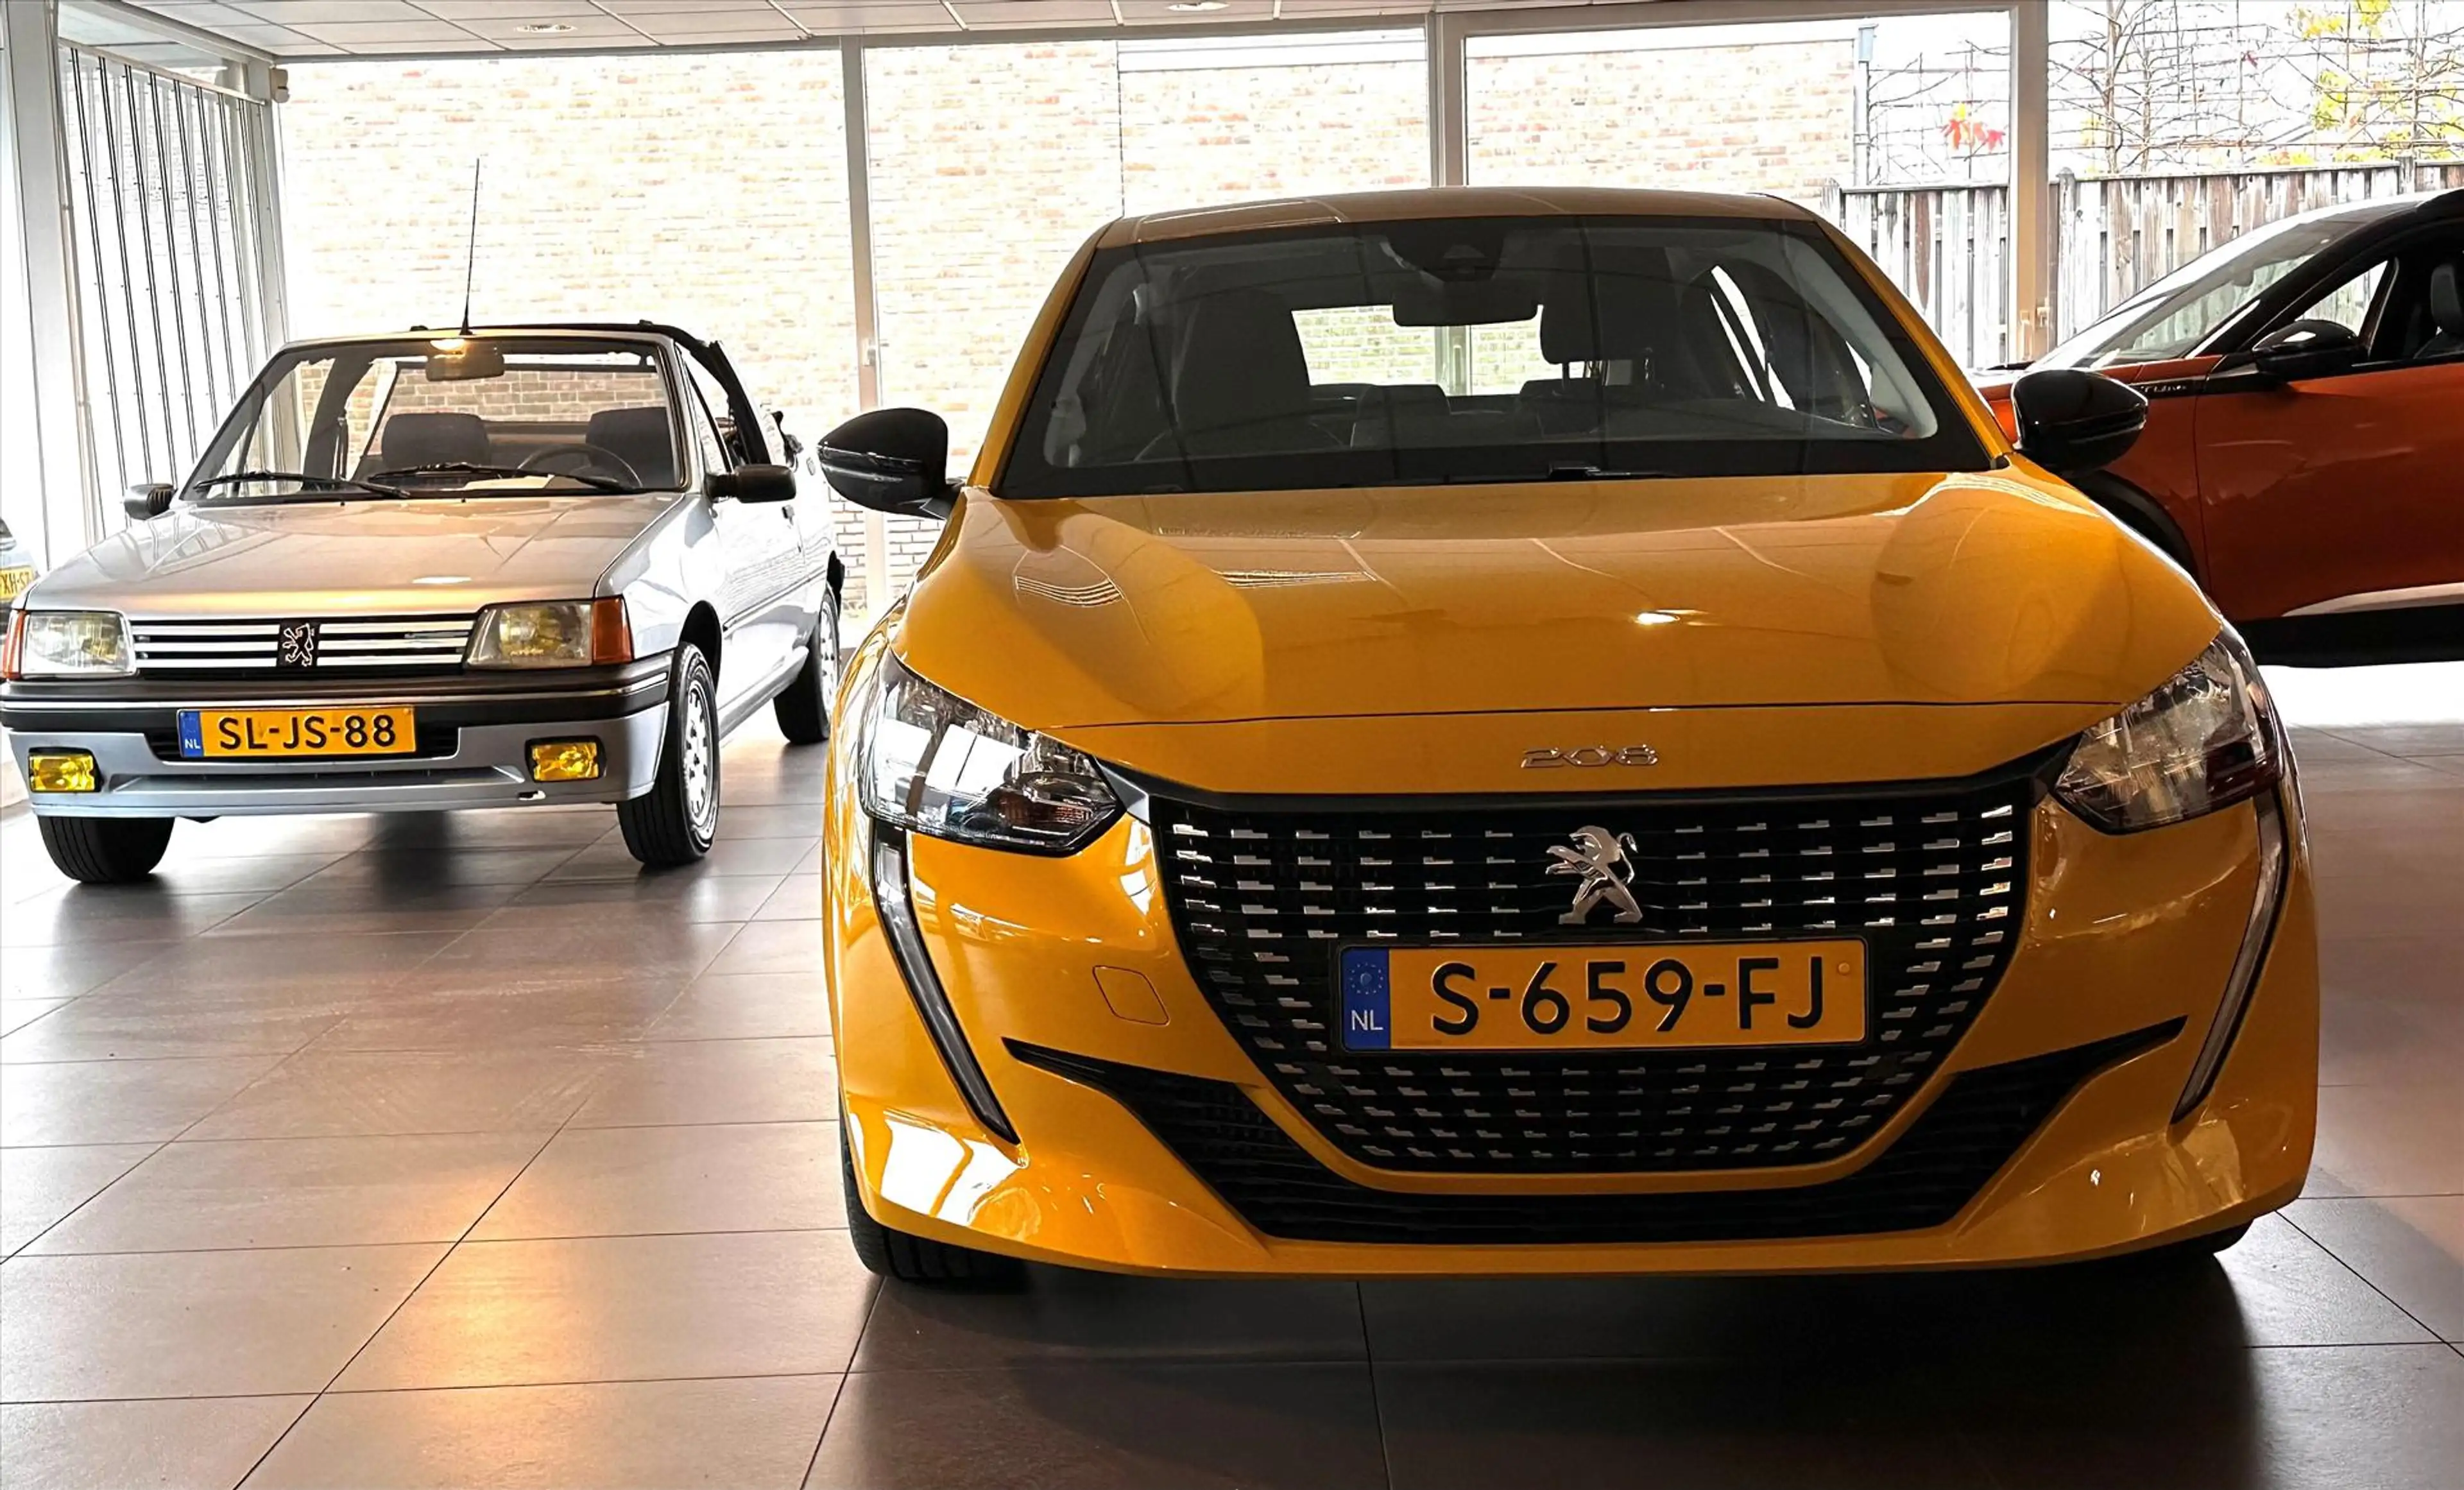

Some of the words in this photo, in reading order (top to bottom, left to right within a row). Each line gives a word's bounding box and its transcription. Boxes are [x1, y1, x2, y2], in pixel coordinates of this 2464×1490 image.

[184, 739, 201, 749] NL
[218, 715, 397, 750] SL-JS-88
[1520, 744, 1659, 769] 208
[1351, 1009, 1384, 1031] NL
[1431, 955, 1824, 1036] S-659-FJ
